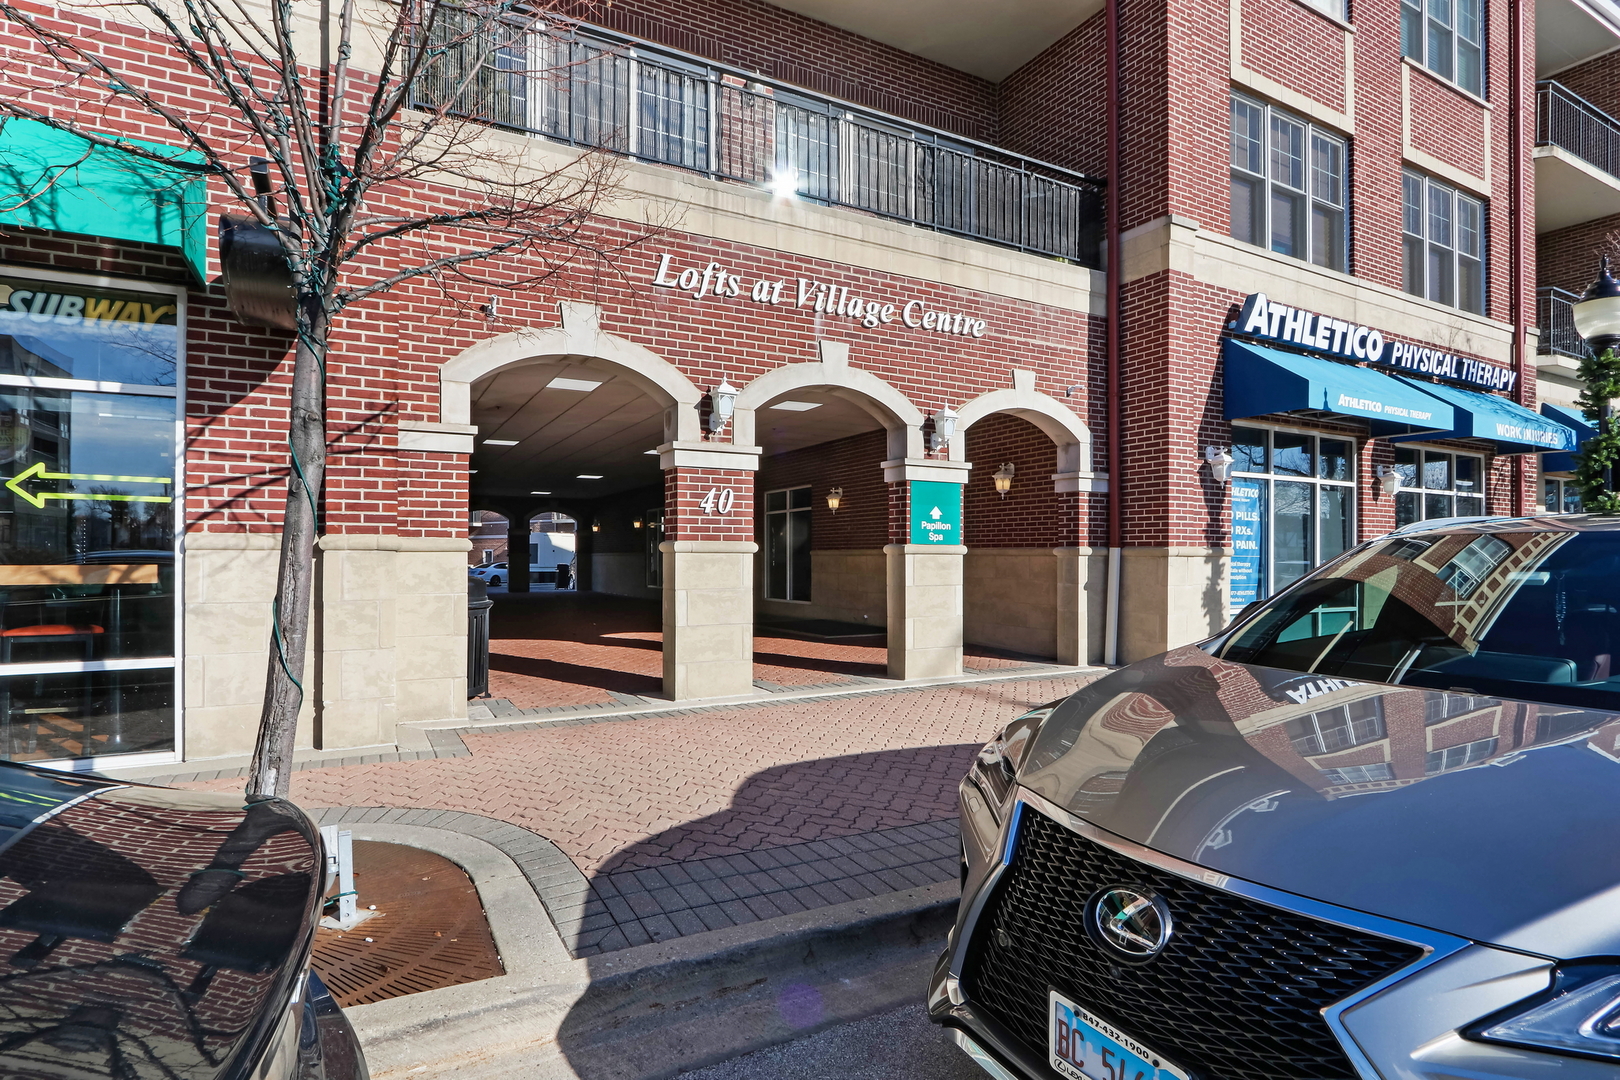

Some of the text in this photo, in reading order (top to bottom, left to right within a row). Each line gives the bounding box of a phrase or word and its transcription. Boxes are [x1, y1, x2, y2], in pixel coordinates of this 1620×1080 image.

[652, 252, 986, 338] Lofts at Village Centre
[9, 290, 176, 331] SUBWAY
[1244, 292, 1517, 392] ATHLETICO PHYSICAL THERAPY
[1338, 393, 1432, 420] ATHLETICO PHYSICAL THERAPY
[1496, 423, 1558, 445] WORK INJURIES
[700, 487, 734, 514] 40
[1231, 487, 1259, 498] HLETICO
[921, 520, 951, 532] Papillon
[1236, 511, 1260, 521] PILLS.
[929, 532, 943, 543] Spa
[1235, 525, 1253, 535] RXs.
[1235, 540, 1258, 550] PAIN.
[1057, 1018, 1084, 1069] BC
[1083, 1012, 1149, 1060] 847-432-1900
